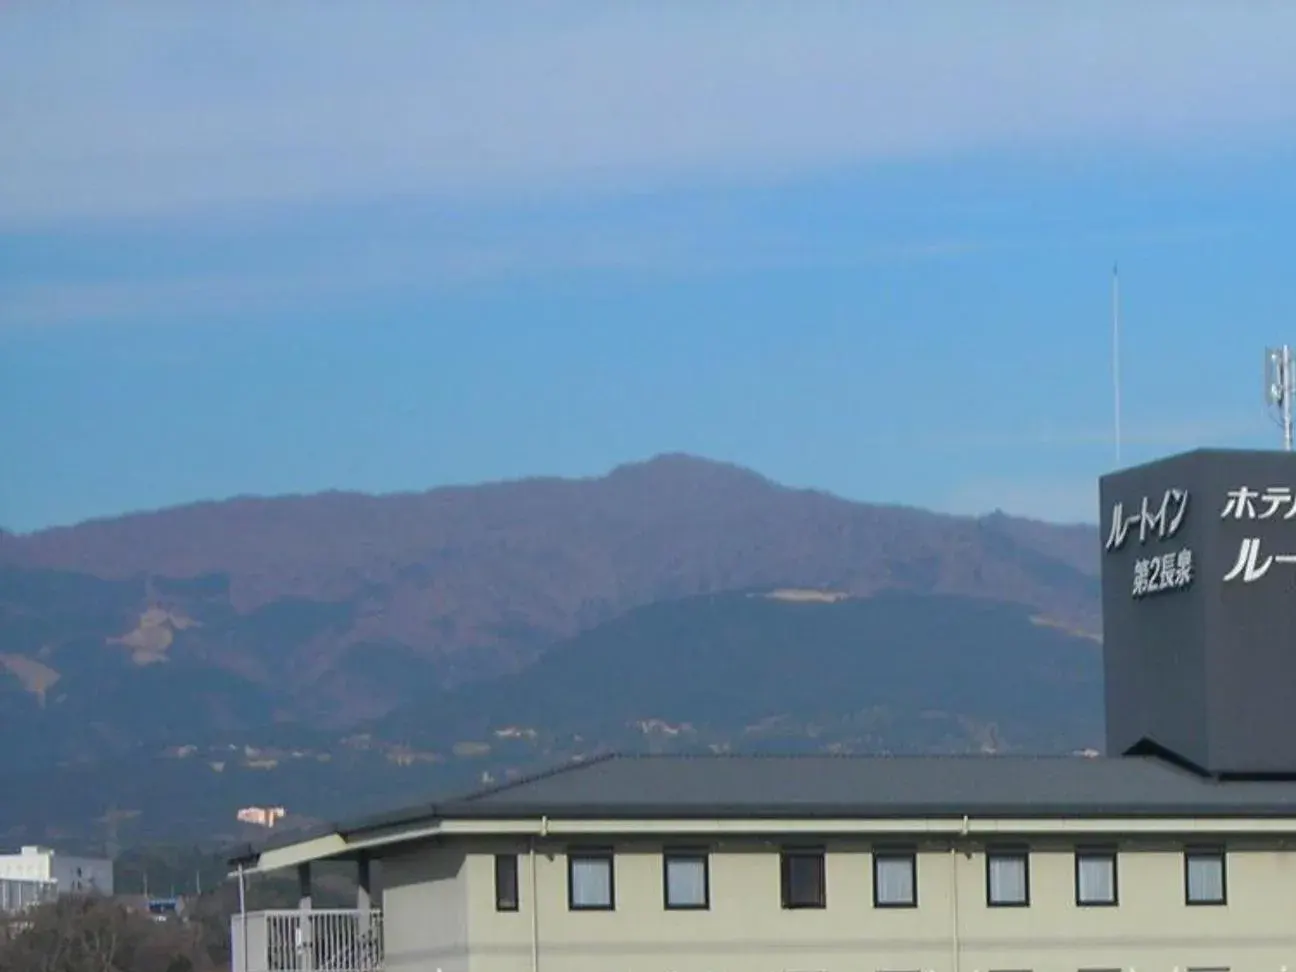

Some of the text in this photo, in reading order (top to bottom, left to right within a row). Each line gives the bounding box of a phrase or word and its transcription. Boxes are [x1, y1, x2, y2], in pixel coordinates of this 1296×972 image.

[1105, 488, 1188, 549] ルートイン
